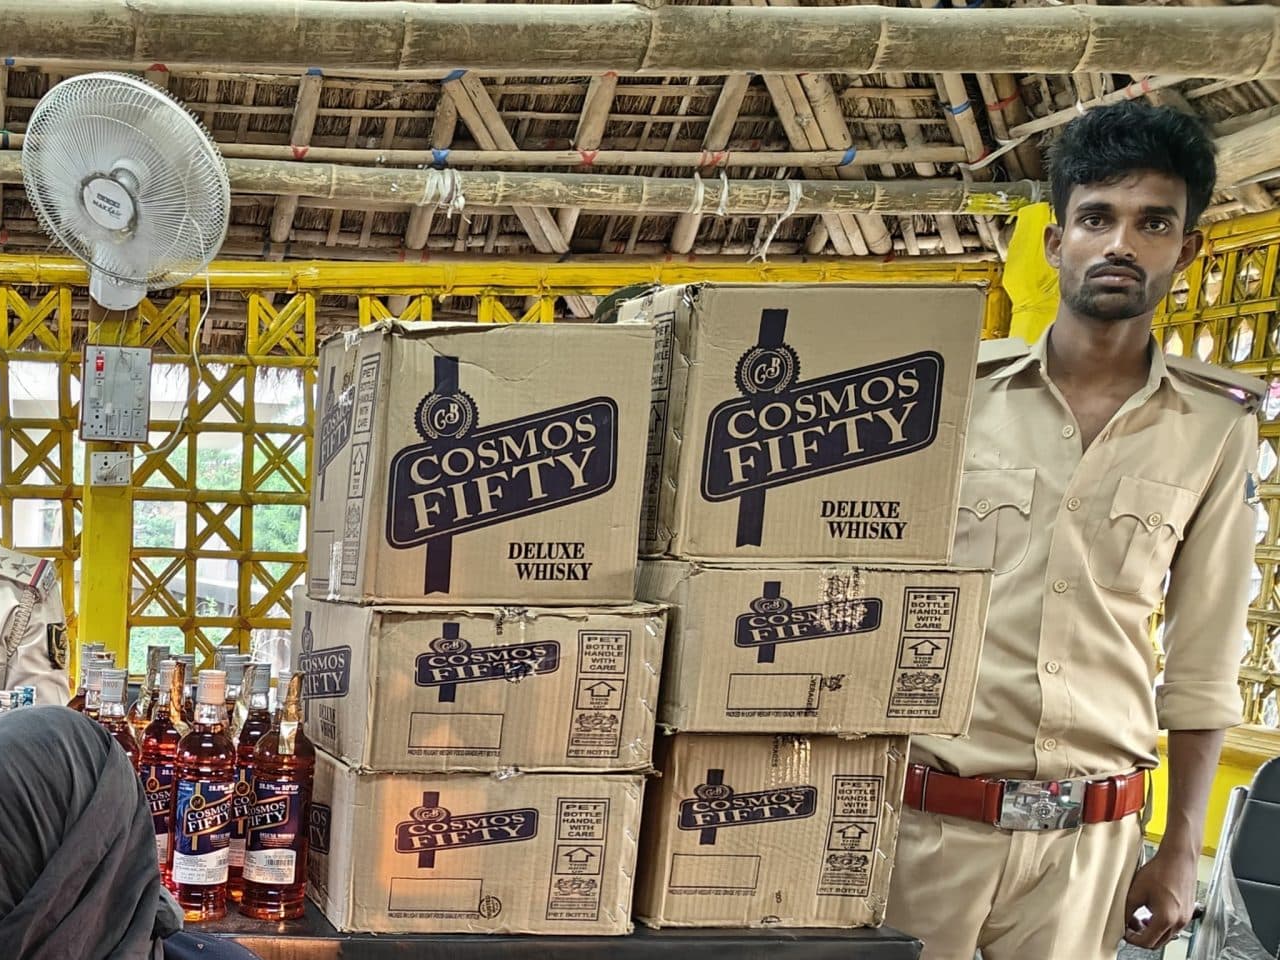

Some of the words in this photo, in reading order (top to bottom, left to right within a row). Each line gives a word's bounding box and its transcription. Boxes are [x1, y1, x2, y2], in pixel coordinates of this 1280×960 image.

[727, 367, 920, 439] COSMOS
[410, 413, 597, 486] COSMOS
[724, 401, 918, 486] FIFTY
[408, 446, 596, 533] FIFTY
[820, 500, 901, 519] DELUXE
[826, 520, 907, 540] WHISKY
[508, 542, 584, 560] DELUXE
[515, 562, 593, 581] WHISKY
[301, 653, 345, 673] COSMOS
[428, 646, 547, 668] COSMOS
[187, 800, 231, 821] COSMOS
[692, 791, 805, 813] COSMOS
[188, 811, 230, 832] FIFTY
[408, 813, 525, 836] COSMOS
[692, 802, 801, 826] FIFTY
[409, 824, 526, 849] FIFTY
